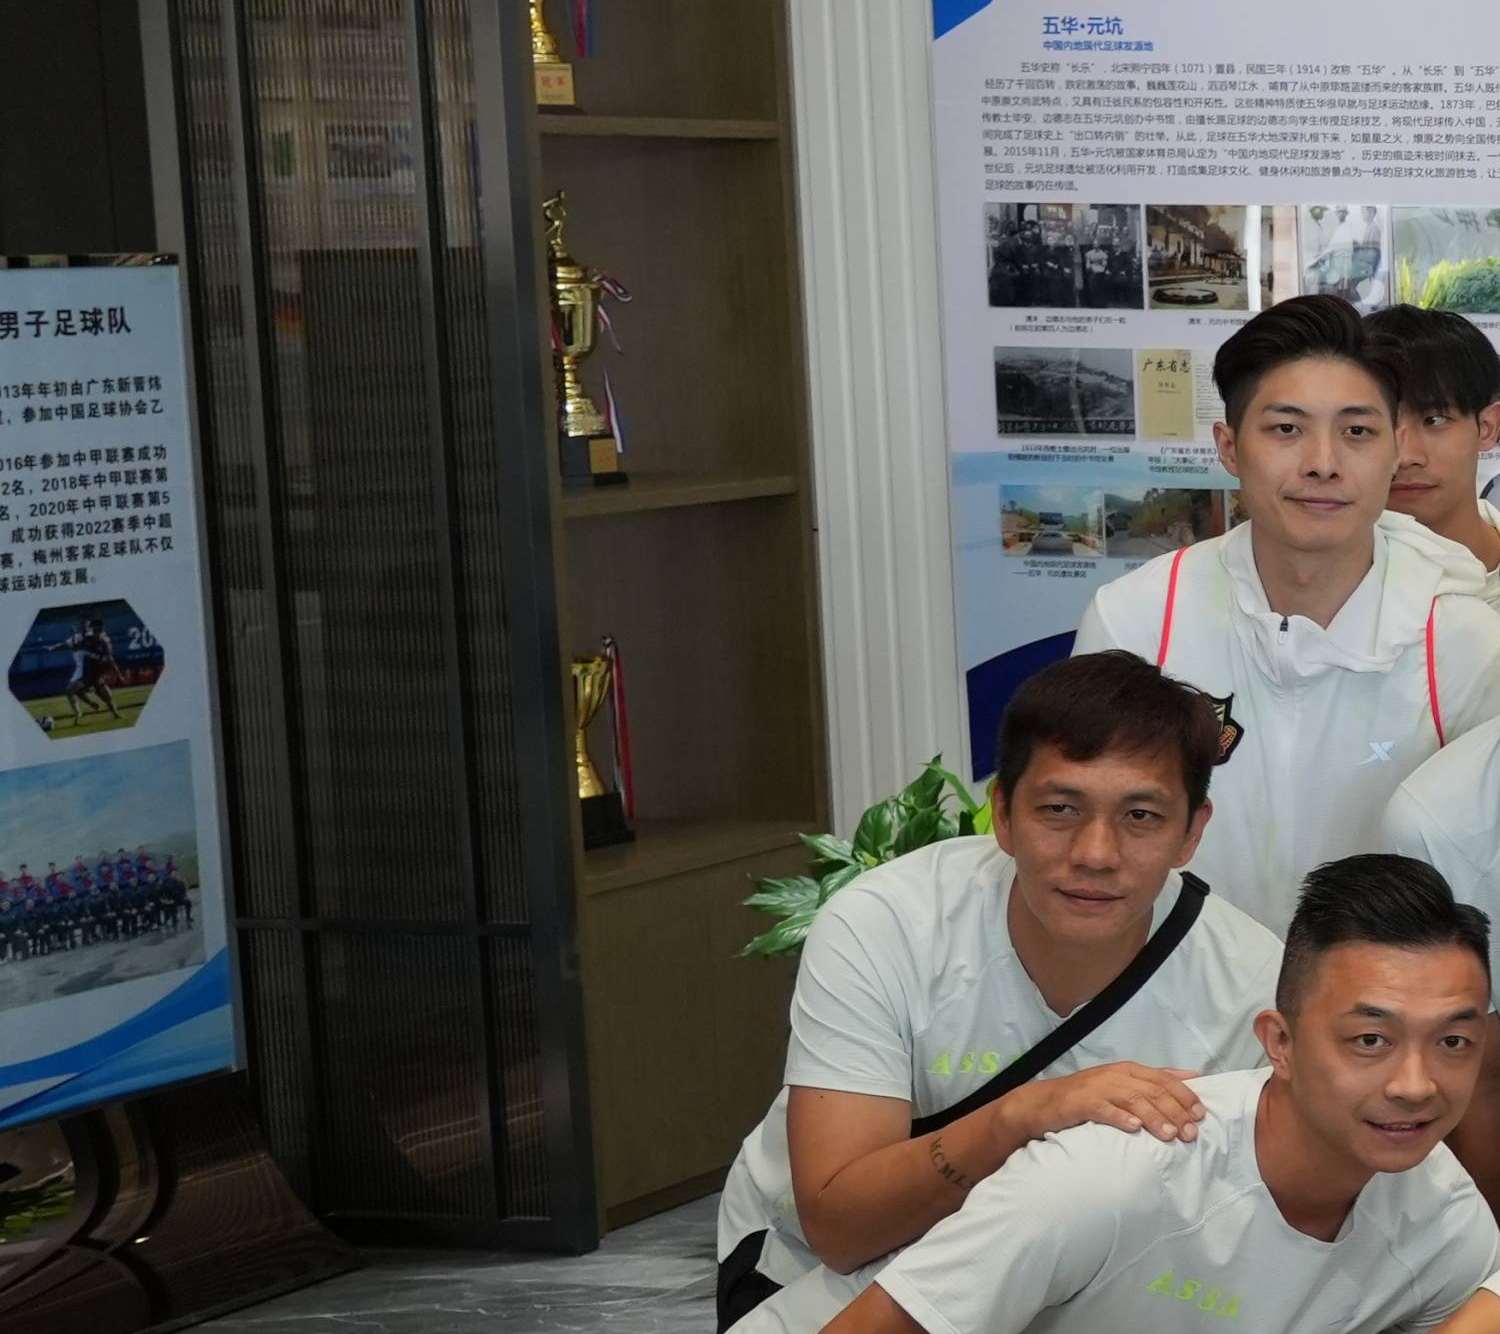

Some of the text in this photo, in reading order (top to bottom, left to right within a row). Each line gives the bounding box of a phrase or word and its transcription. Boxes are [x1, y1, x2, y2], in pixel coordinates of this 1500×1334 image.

[0, 376, 162, 399] 13年年初由广东新晋炜
[0, 399, 164, 425] ，参加中国足球协会乙
[928, 1051, 1022, 1076] ASS
[1145, 1269, 1240, 1319] ASSA
